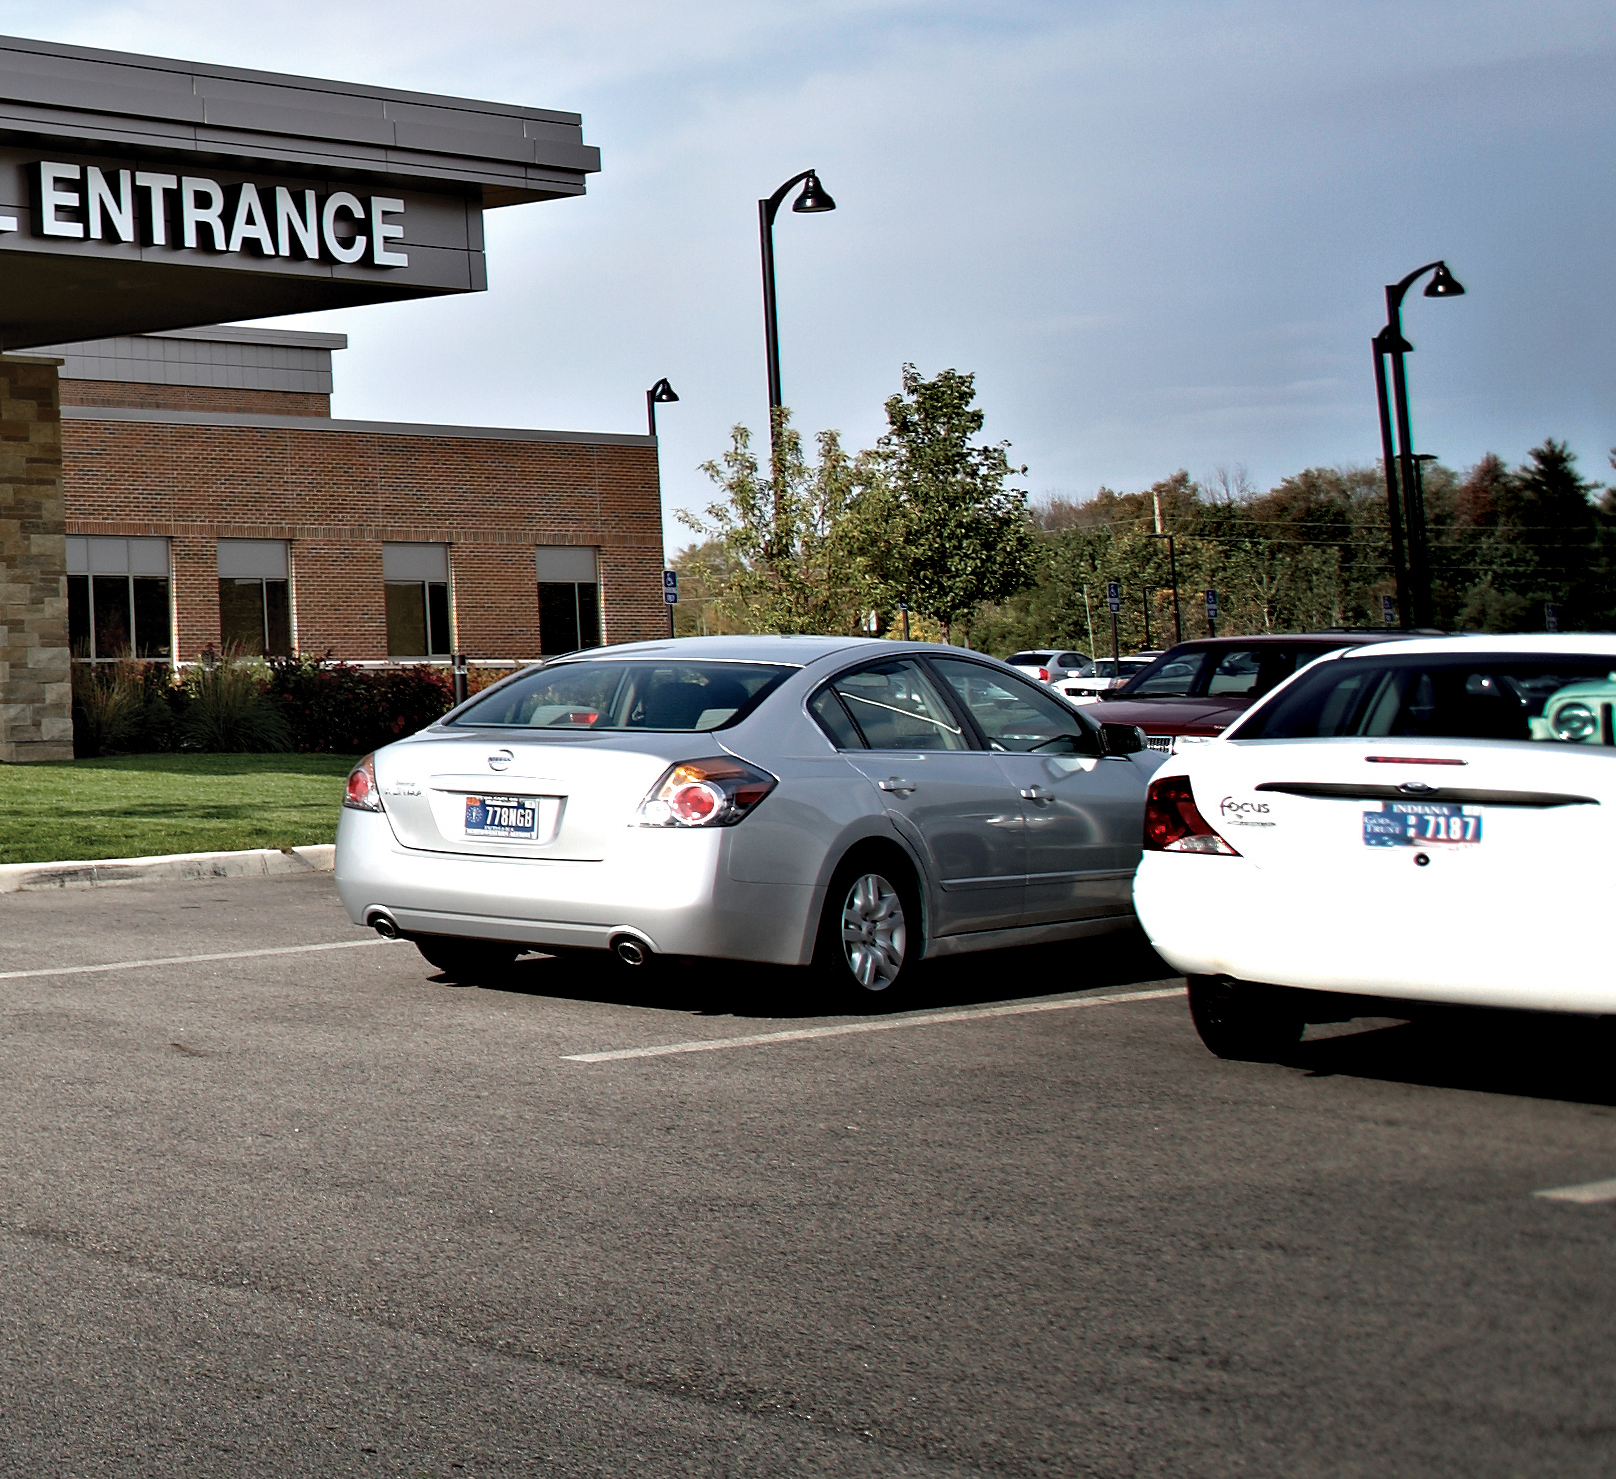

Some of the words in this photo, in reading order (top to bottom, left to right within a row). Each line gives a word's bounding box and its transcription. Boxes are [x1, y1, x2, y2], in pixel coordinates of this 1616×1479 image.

[40, 161, 409, 268] ENTRANCE
[486, 807, 533, 828] 778NGB
[1392, 804, 1449, 815] INDIANA
[1423, 815, 1476, 841] 7187
